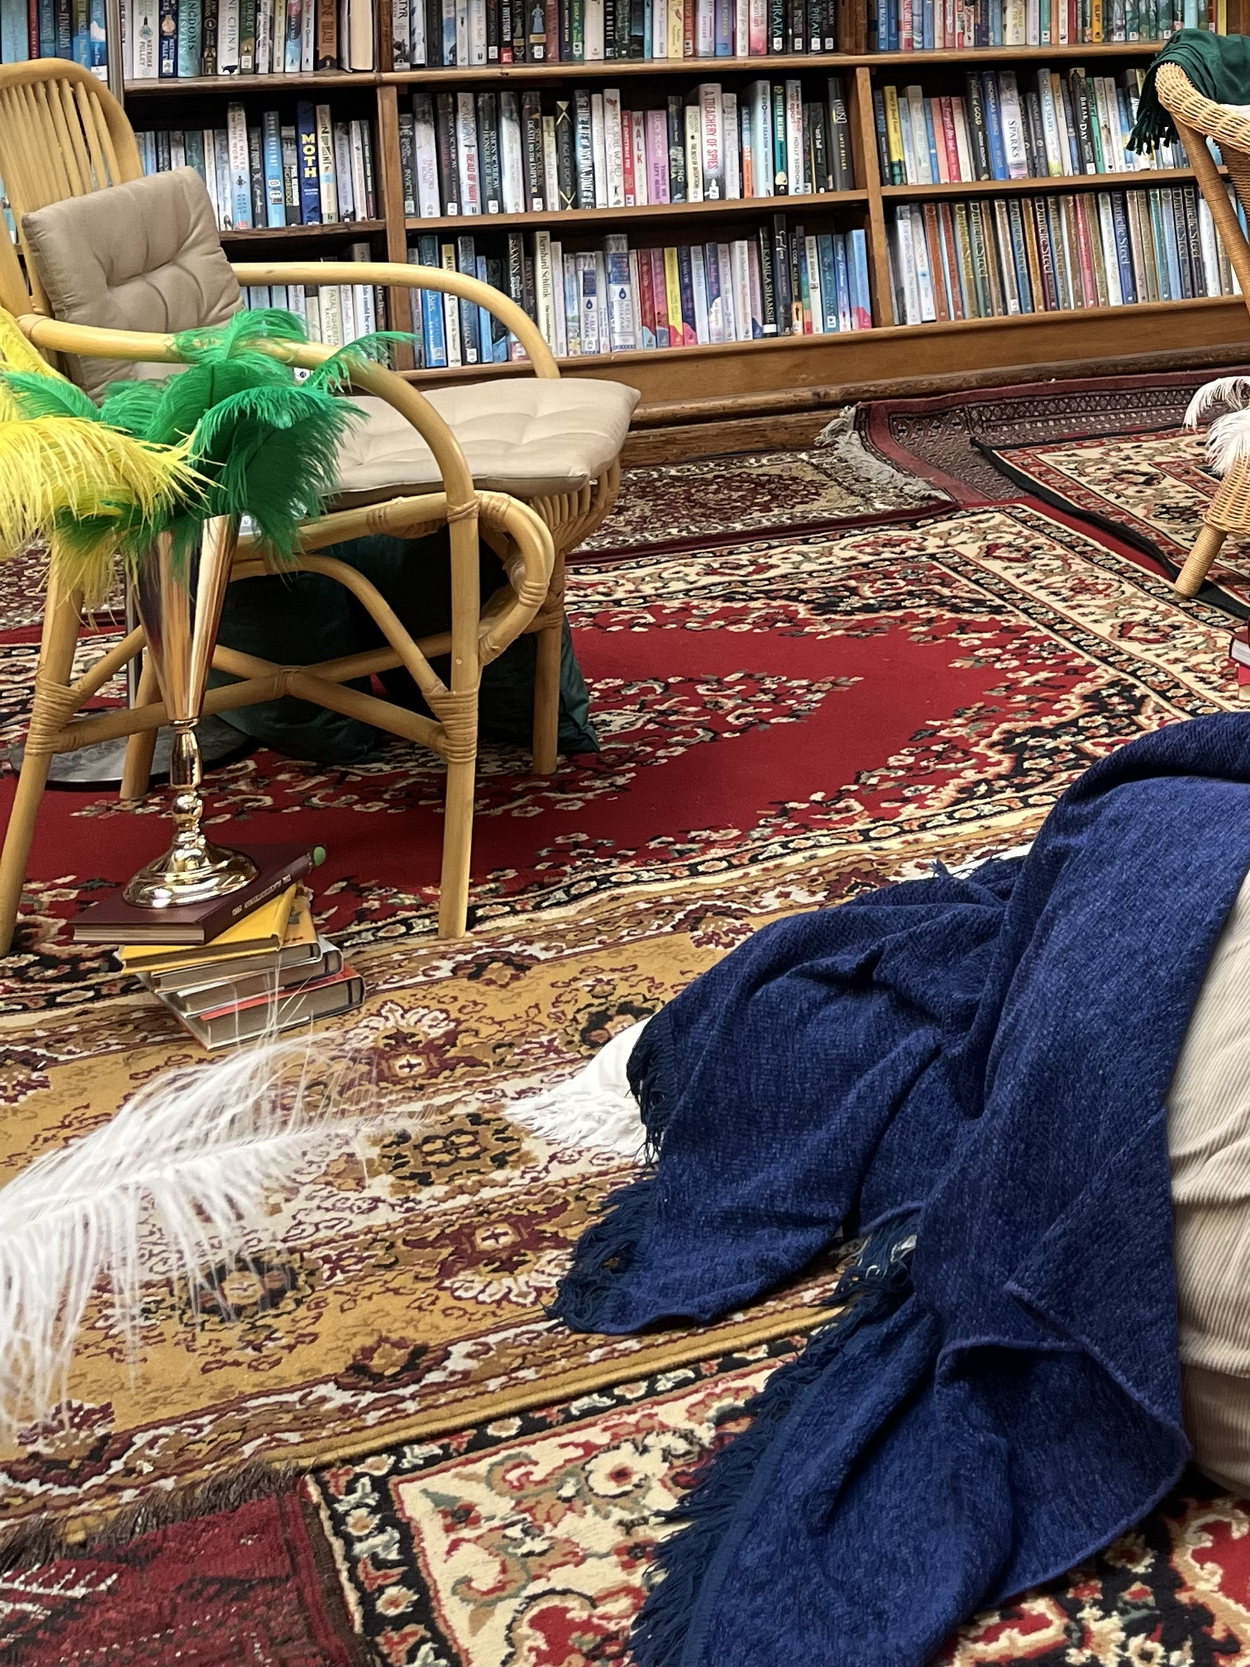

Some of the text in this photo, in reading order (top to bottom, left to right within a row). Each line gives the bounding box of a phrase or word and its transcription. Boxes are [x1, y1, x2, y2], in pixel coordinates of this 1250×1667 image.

[228, 18, 236, 52] CHINA
[704, 98, 716, 136] TREACHERY
[706, 139, 717, 148] OF
[1008, 121, 1019, 158] SPARKS
[1079, 124, 1088, 140] DAY
[707, 149, 718, 169] SPIES
